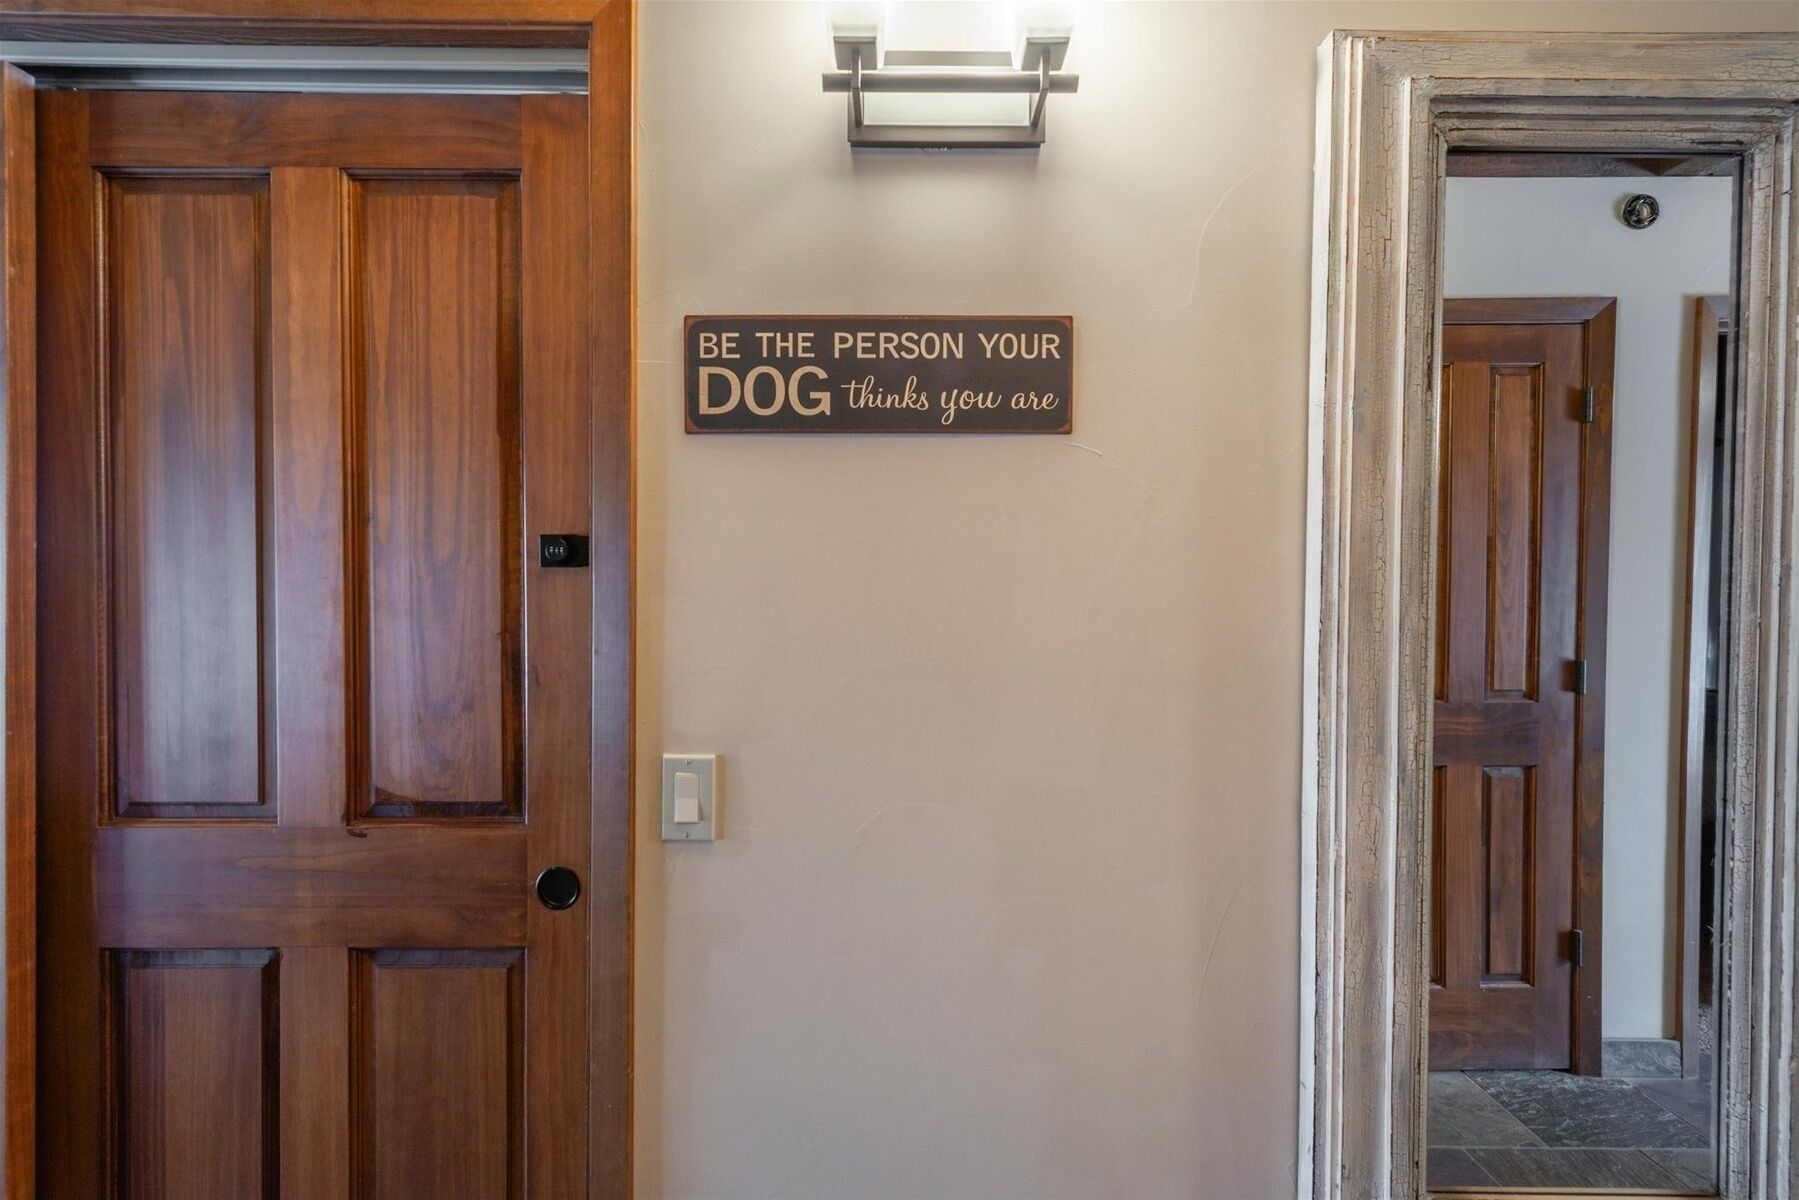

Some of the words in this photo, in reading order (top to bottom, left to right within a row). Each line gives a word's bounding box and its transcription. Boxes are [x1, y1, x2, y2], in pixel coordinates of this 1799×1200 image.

[700, 332, 741, 359] BE
[755, 332, 815, 358] THE
[834, 332, 964, 360] PERSON
[978, 332, 1061, 360] YOUR
[698, 366, 831, 416] DOG
[841, 375, 929, 411] thinks
[940, 387, 1002, 425] you
[1010, 390, 1060, 411] are
